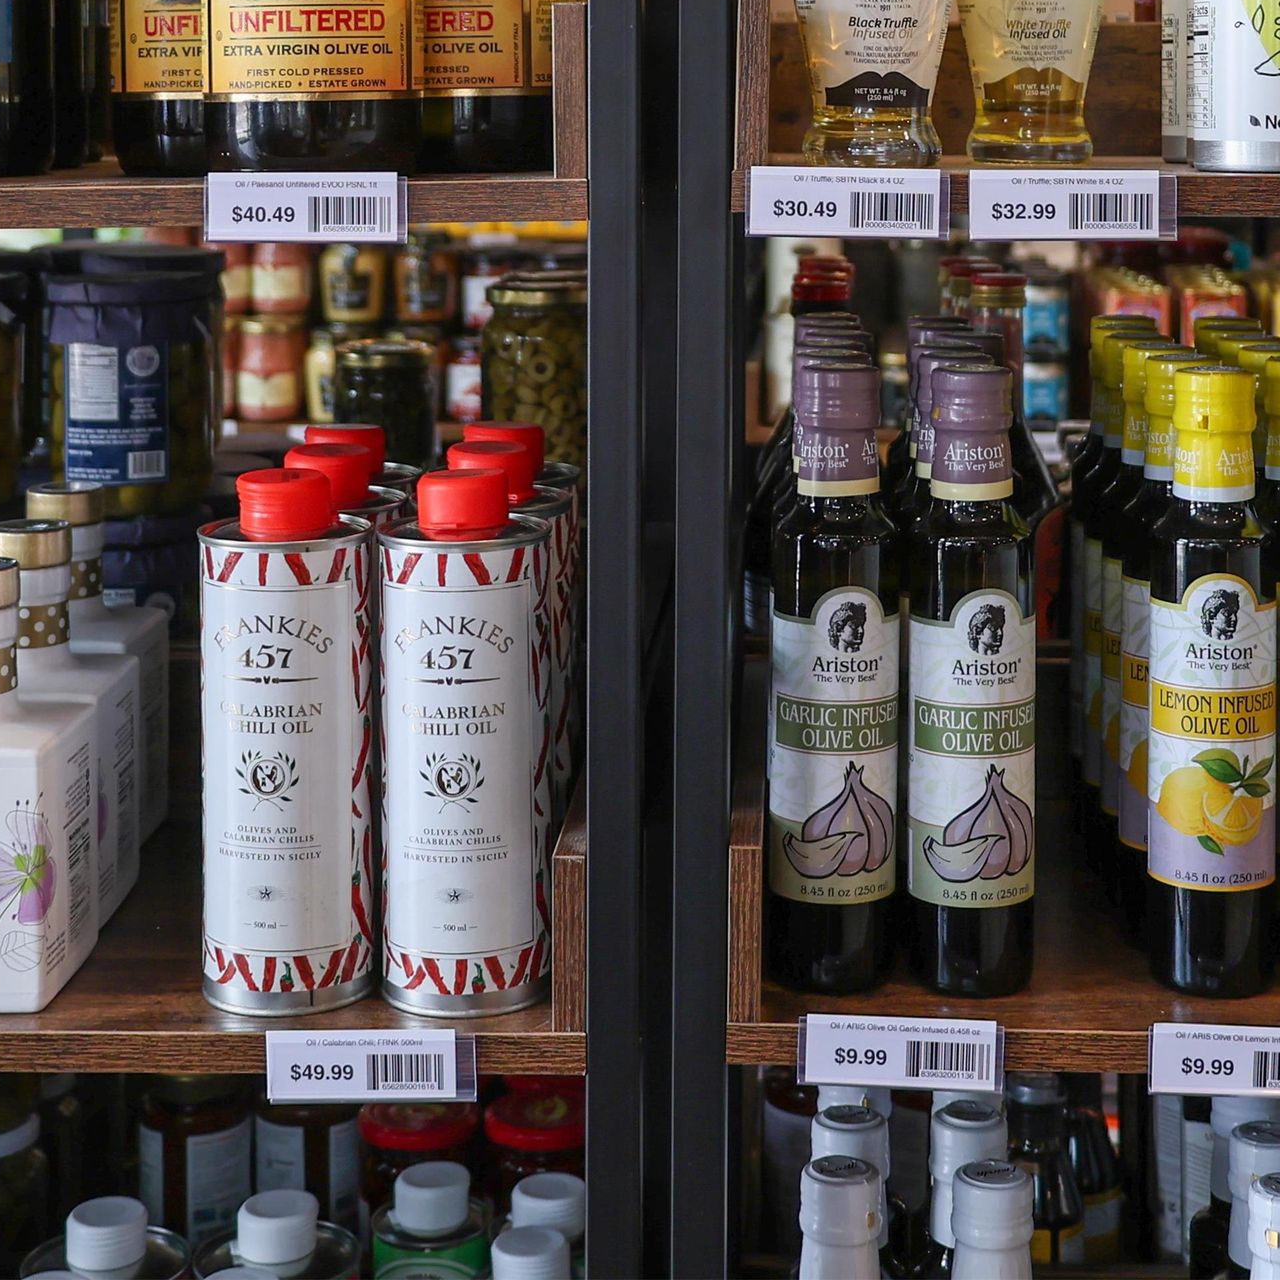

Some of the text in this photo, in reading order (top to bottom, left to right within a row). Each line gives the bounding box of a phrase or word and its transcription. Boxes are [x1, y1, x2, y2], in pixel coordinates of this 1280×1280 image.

[229, 8, 385, 34] UNFILTERED
[849, 16, 918, 28] Black Truffle
[1006, 19, 1071, 30] White Truffle
[853, 28, 914, 40] Infused Oil
[1010, 28, 1066, 40] Infused Oil
[223, 42, 393, 57] EXTRA VIRGIN OLIVE OIL
[246, 67, 363, 77] FIRST COLD PRESSED
[228, 79, 386, 89] HAND-PICKED ESTATE GROWN
[835, 176, 857, 184] SBTN
[859, 176, 878, 184] Black
[880, 177, 892, 185] 8.4
[232, 206, 295, 222] $40.49
[773, 199, 837, 218] $30.49
[992, 202, 1056, 221] $32.99
[214, 614, 334, 656] FRANKIES
[240, 645, 293, 670] 457
[1185, 642, 1253, 660] Ariston
[812, 657, 879, 673] Ariston
[1159, 689, 1274, 712] LEMON INFUSED
[781, 702, 837, 725] GARLIC
[1181, 715, 1260, 736] OLIVE OIL
[802, 727, 883, 749] OLIVE OIL
[223, 832, 275, 844] CALABRIAN
[237, 825, 297, 835] OLIVES AND
[1192, 1032, 1211, 1040] ARIS
[1212, 1033, 1231, 1041] Olive
[1245, 1035, 1270, 1043] Lemon
[835, 1047, 887, 1065] $9.99
[291, 1064, 354, 1081] $49.99
[1181, 1057, 1234, 1075] $9.99
